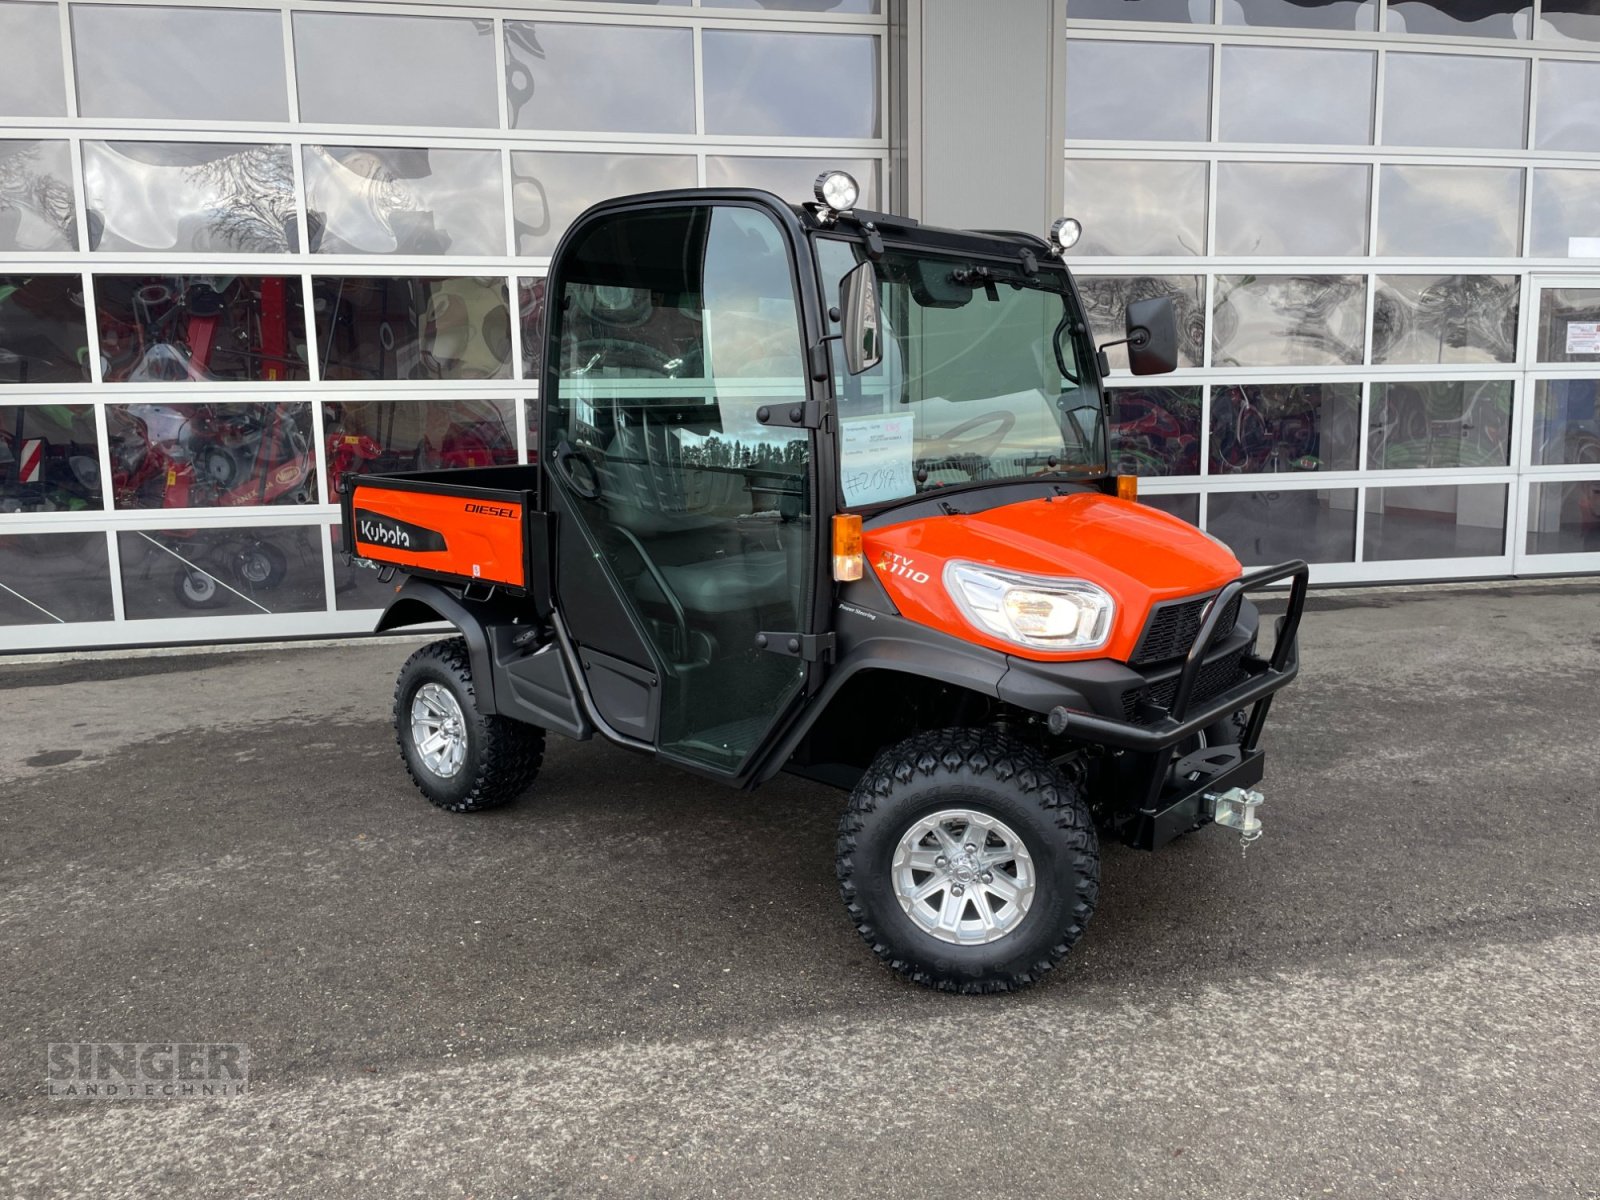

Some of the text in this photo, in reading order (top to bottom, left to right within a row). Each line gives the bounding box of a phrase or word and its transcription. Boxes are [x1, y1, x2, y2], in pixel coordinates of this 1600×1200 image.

[464, 503, 518, 519] DIESEL
[360, 520, 410, 547] Kubota
[882, 551, 914, 566] RTV
[876, 559, 930, 584] X1110
[839, 603, 876, 620] Power Steering
